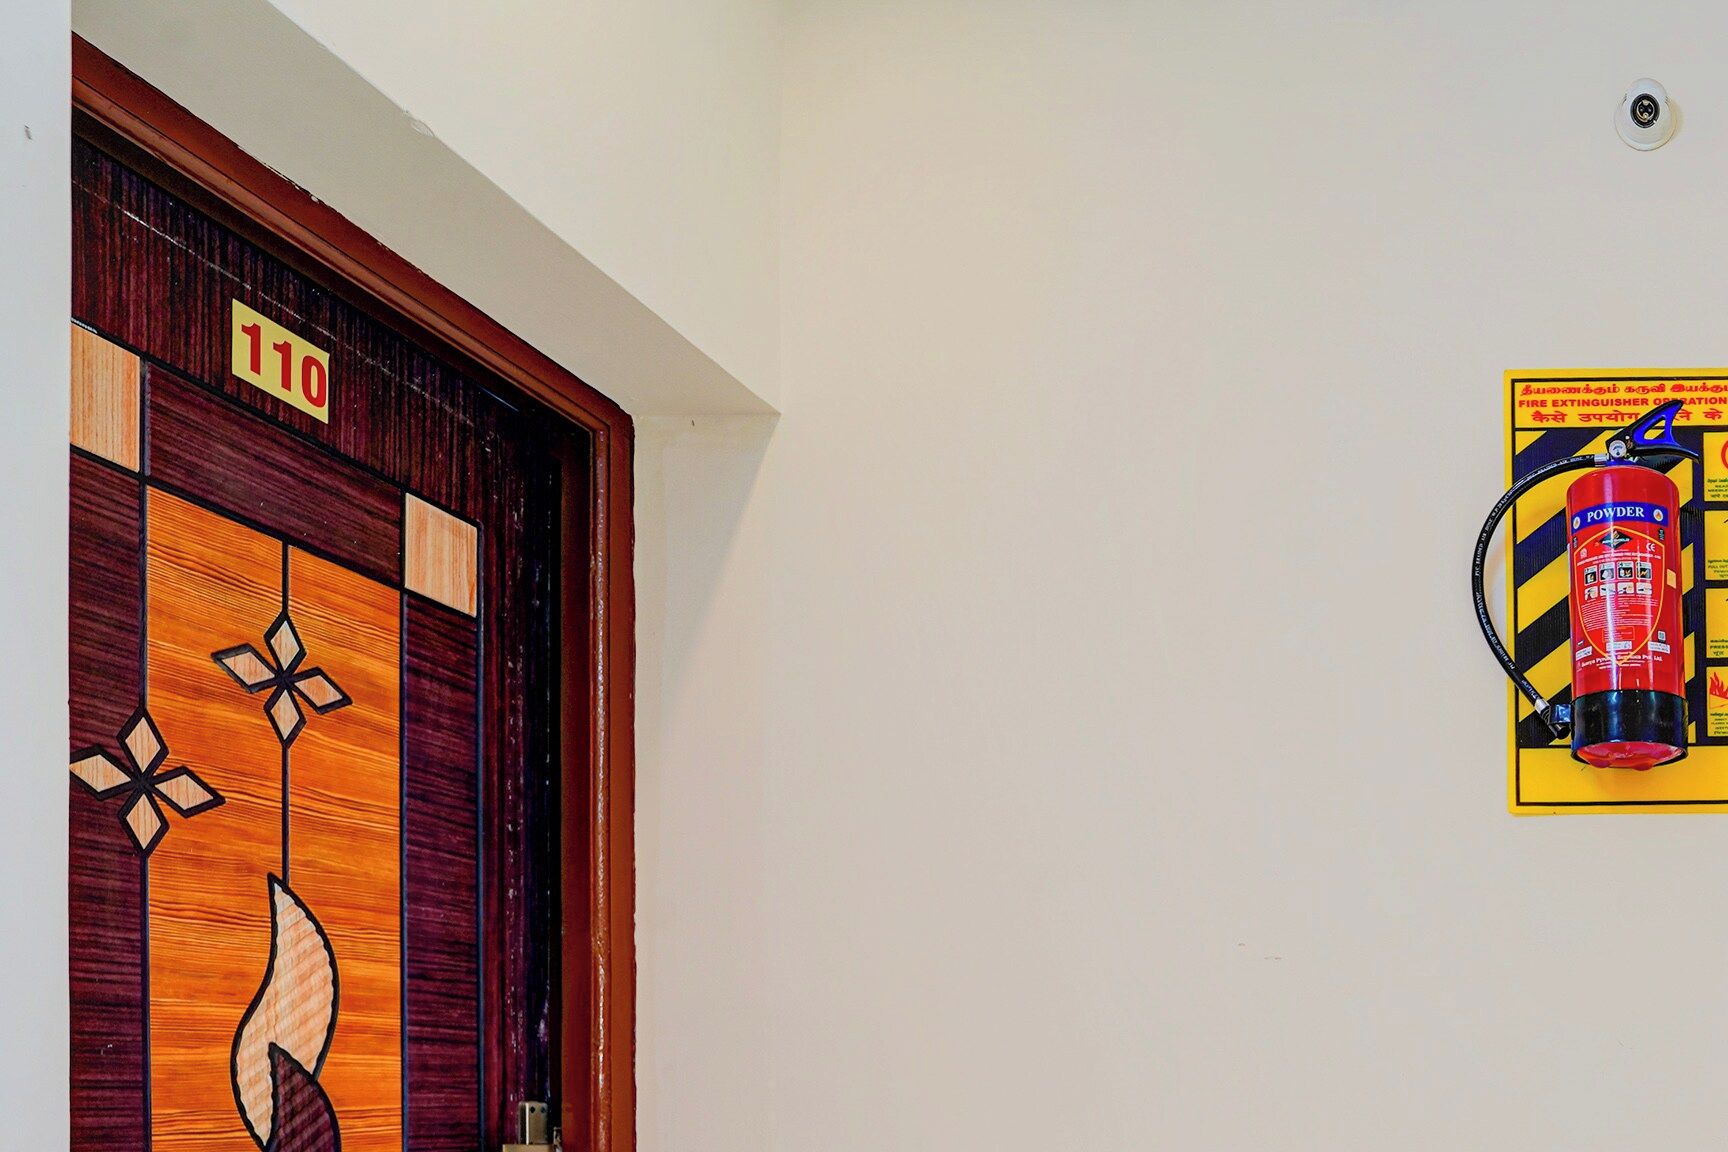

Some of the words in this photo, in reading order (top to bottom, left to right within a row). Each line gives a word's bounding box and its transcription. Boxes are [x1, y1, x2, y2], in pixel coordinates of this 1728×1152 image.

[241, 323, 327, 408] 110
[1518, 399, 1548, 408] FIRE
[1551, 398, 1649, 408] EXTINGUISHER
[1531, 410, 1568, 423] कैसे
[1703, 408, 1723, 421] के
[1587, 506, 1645, 523] POWDER
[1646, 542, 1656, 552] CE
